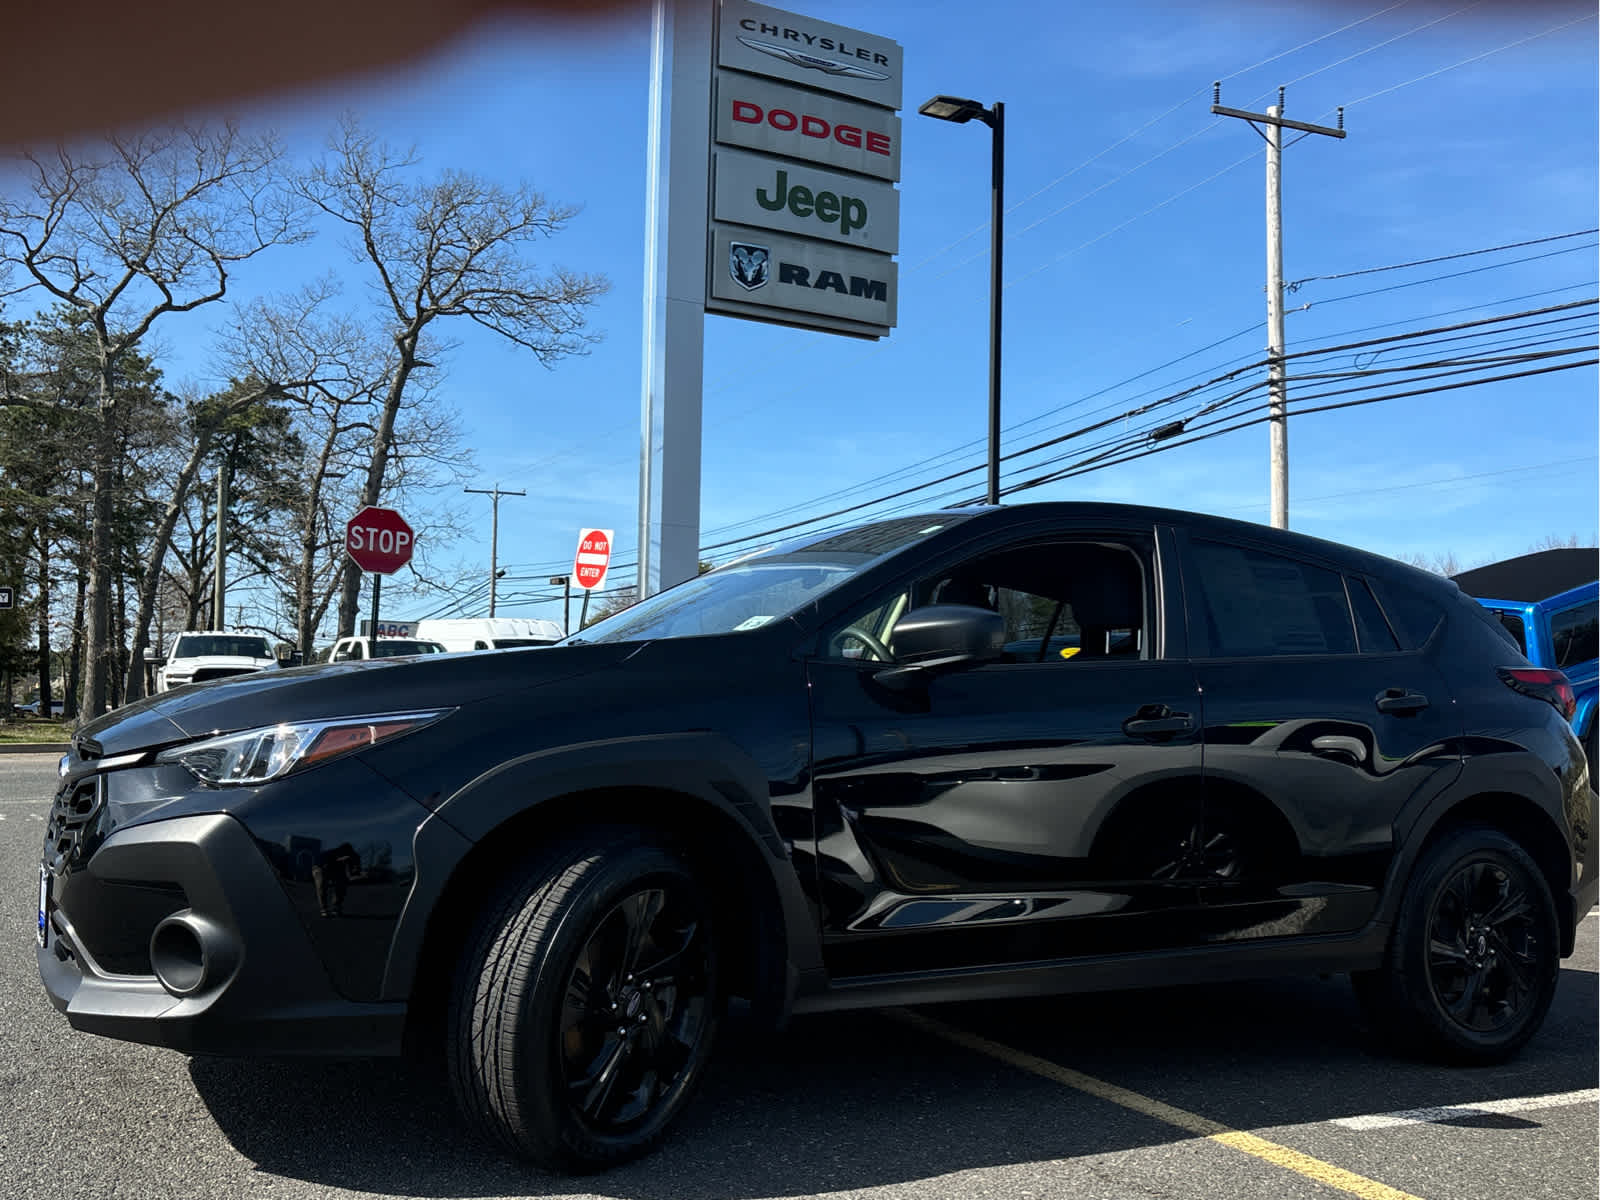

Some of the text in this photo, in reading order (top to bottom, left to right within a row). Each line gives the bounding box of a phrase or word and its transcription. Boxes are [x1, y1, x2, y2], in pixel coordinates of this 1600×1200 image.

[739, 18, 889, 67] CHRYSLER
[732, 100, 891, 156] DODGE
[756, 170, 868, 235] Jeep
[778, 262, 888, 302] RAM
[350, 525, 410, 555] STOP
[583, 540, 608, 551] DO NOT
[580, 567, 600, 578] ENTER
[376, 623, 409, 637] ABC
